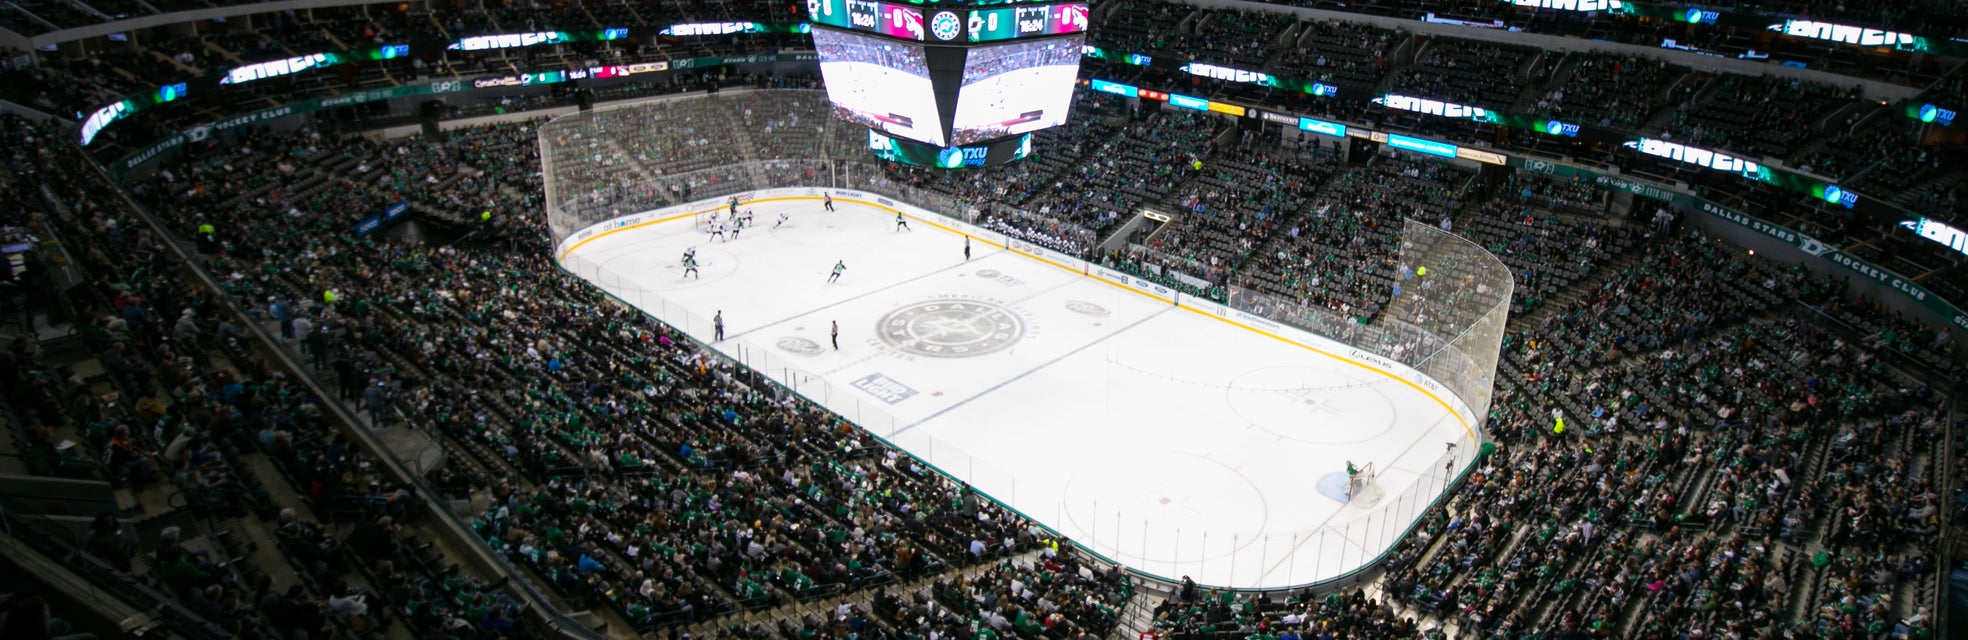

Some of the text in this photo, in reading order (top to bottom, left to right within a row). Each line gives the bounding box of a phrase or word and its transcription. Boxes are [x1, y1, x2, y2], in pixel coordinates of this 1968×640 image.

[893, 9, 903, 28] 0
[988, 12, 998, 32] 0
[1061, 7, 1071, 25] 0
[1562, 123, 1580, 133] TXU
[963, 146, 988, 159] TXU
[963, 158, 986, 167] energy
[1841, 190, 1858, 203] TXU
[1703, 203, 1750, 226] DALLAS
[1753, 221, 1796, 243] STARS
[1834, 253, 1889, 282] HOCKEY
[1892, 279, 1926, 302] CLUB
[923, 303, 1012, 341] DALLAS
[853, 377, 903, 403] LIGHT
[1424, 379, 1438, 392] AT&T
